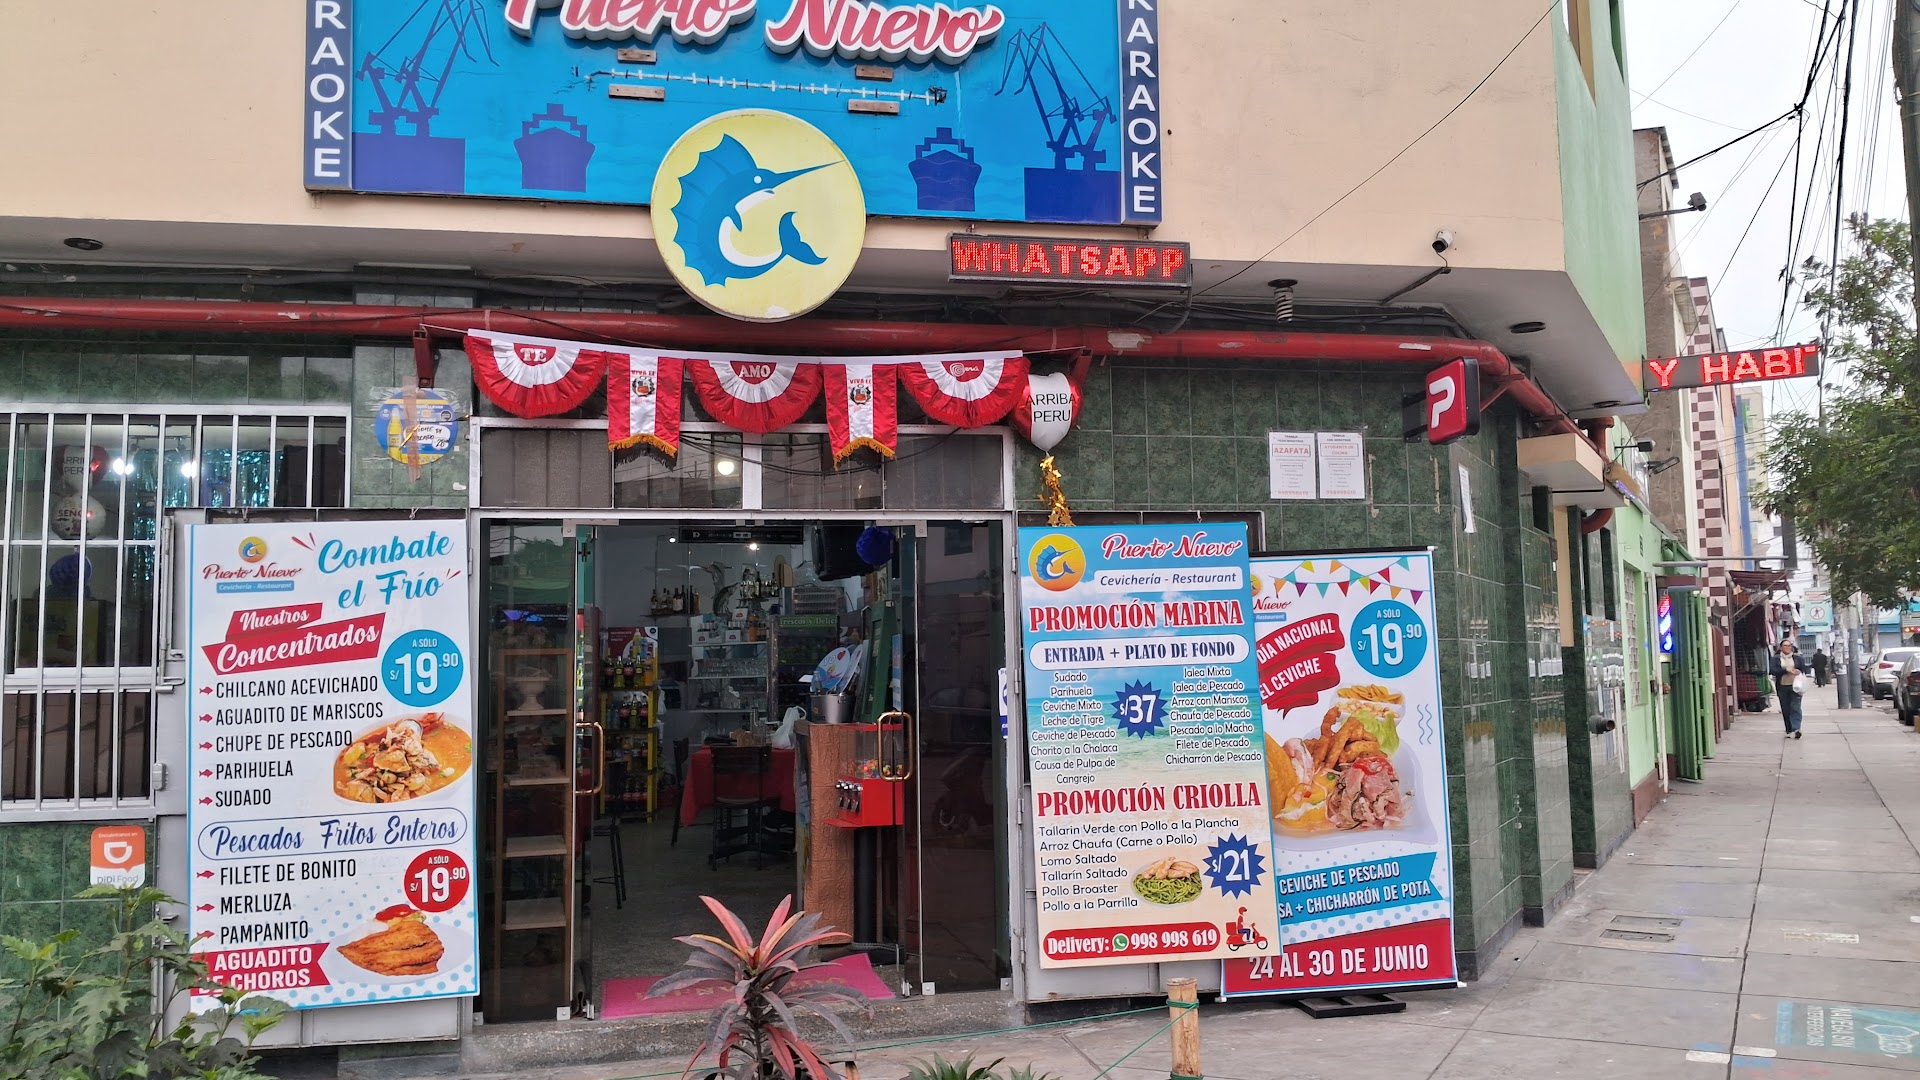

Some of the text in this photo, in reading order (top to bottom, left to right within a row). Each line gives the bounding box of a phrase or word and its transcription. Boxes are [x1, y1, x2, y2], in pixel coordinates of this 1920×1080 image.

[952, 241, 1184, 278] WHATSAPP
[520, 347, 547, 362] TE
[739, 365, 771, 379] AMO
[1650, 358, 1679, 388] Y
[1026, 393, 1078, 406] ARRIBA
[1034, 410, 1071, 422] PERU
[318, 531, 454, 574] Combate
[1102, 532, 1242, 559] Puerto Nuevo
[203, 562, 302, 579] Puerto Nuevo
[1101, 572, 1236, 586] Cevichería Restaurant
[338, 570, 443, 609] el Frío
[1254, 596, 1291, 610] Nuevo
[239, 610, 310, 631] Nuestros
[1030, 600, 1243, 631] PROMOCIÓN MARINA
[1383, 608, 1401, 618] SÓLO
[418, 638, 438, 648] SÓLO
[1274, 619, 1335, 651] NACIONAL
[216, 624, 379, 673] Concentrados
[1045, 640, 1235, 663] ENTRADA PLATO DE FONDO
[1054, 672, 1087, 682] Sudado
[1184, 667, 1231, 677] Jalea Mixta
[1270, 657, 1321, 691] CEVICHE
[216, 676, 378, 698] CHILCANO ACEVICHADO
[1051, 686, 1092, 697] Parihuela
[1173, 681, 1243, 692] Jalea de Pescado
[1043, 700, 1102, 711] Ceviche Mixto
[1172, 697, 1194, 706] Arroz
[1213, 695, 1248, 704] Mariscos
[216, 702, 383, 725] AGUADITO DE MARISCOS
[1042, 715, 1104, 726] Leche de Tigre
[1170, 709, 1251, 720] Chaufa de Pescado
[1032, 729, 1116, 741] Ceviche de Pescado
[1170, 723, 1253, 735] Pescado Macho
[216, 730, 353, 752] CHUPE DE PESCADO
[1031, 743, 1118, 755] Chorito Chalaca
[1176, 737, 1250, 749] Filete de Pescado
[1034, 757, 1116, 770] Causa de Pulpa de
[1166, 751, 1262, 764] Chicharrón de Pescado
[216, 760, 294, 780] PARIHUELA
[1057, 774, 1095, 784] Cangrejo
[215, 789, 271, 807] SUDADO
[1037, 782, 1261, 816] PROMOCIÓN CRIOLLA
[209, 815, 458, 856] Pescados Fritos Enteros
[1039, 818, 1239, 837] Tallarin Verde con Pollo Plancha
[1039, 834, 1198, 851] Arroz Chaufa (Carne Pollo)
[1040, 854, 1117, 866] Lomo Saltado
[220, 859, 357, 885] FILETE DE BONITO
[1041, 868, 1128, 882] Tallarín Saltado
[1280, 861, 1400, 895] CEVICHE DE PESCADO
[1042, 884, 1118, 896] Pollo Broaster
[1306, 886, 1380, 914] CHICHARRÓN
[1384, 885, 1399, 901] DE
[1401, 880, 1431, 898] POTA
[220, 893, 292, 915] MERLUZA
[1043, 897, 1138, 911] Pollo Parrilla
[220, 921, 309, 944] PAMPANITO
[1047, 929, 1217, 955] Delivery: 998 998 619
[214, 947, 312, 971] AGUADITO
[1249, 943, 1429, 980] 24 AL 30 DE JUNIO
[230, 969, 311, 991] CHOROS
